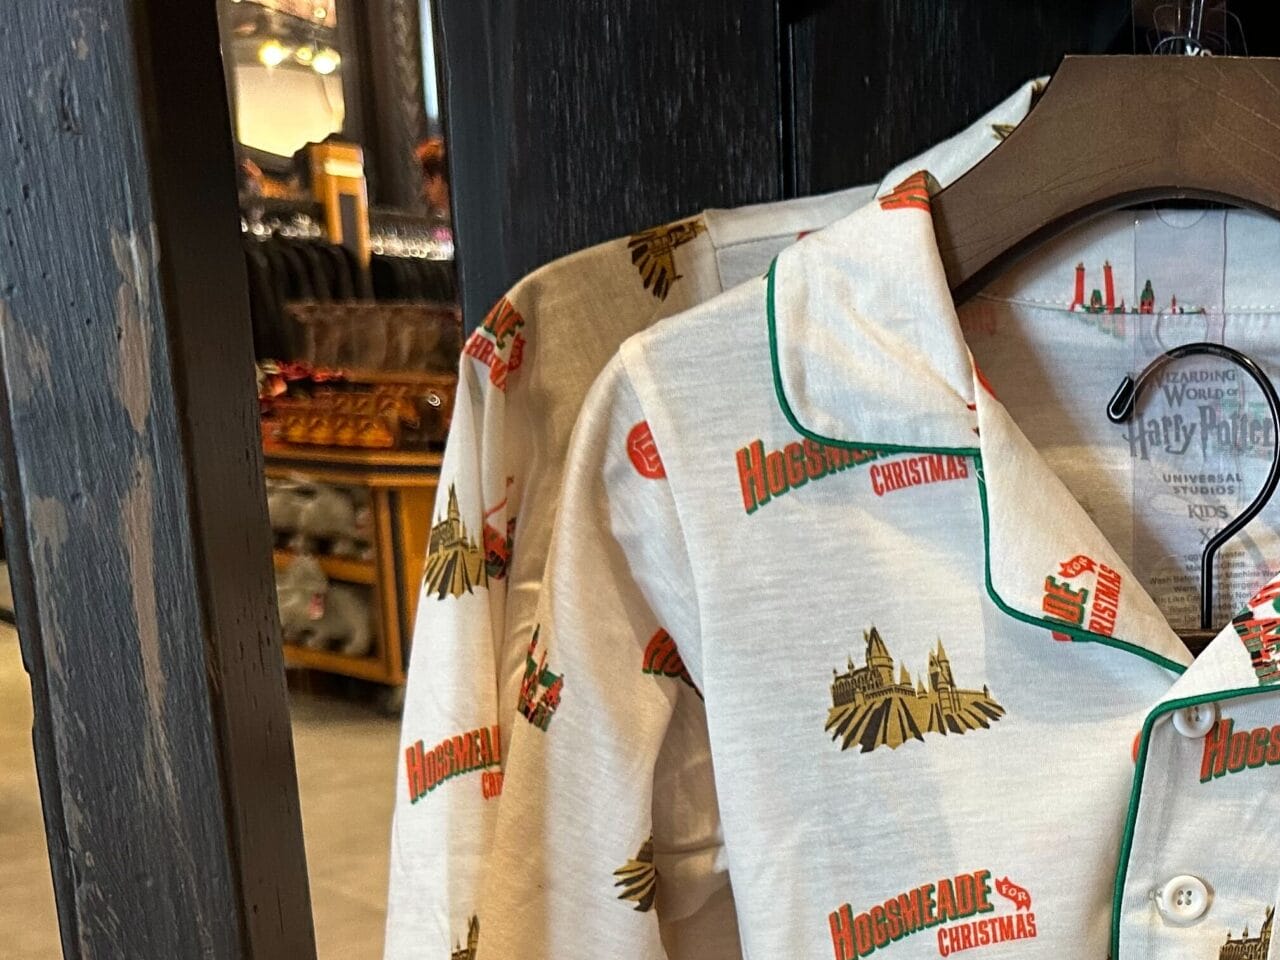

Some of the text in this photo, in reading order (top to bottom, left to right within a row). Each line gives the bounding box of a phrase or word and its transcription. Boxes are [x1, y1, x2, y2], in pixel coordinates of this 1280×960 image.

[1163, 384, 1224, 408] WORLD
[1122, 406, 1275, 463] Harry Potter
[868, 455, 969, 497] CHRISTMAS
[1162, 473, 1242, 483] UNIVERSAL
[1173, 485, 1235, 495] STUDIOS
[1187, 504, 1228, 520] KIDS
[937, 912, 1038, 958] CHRISTMAS
